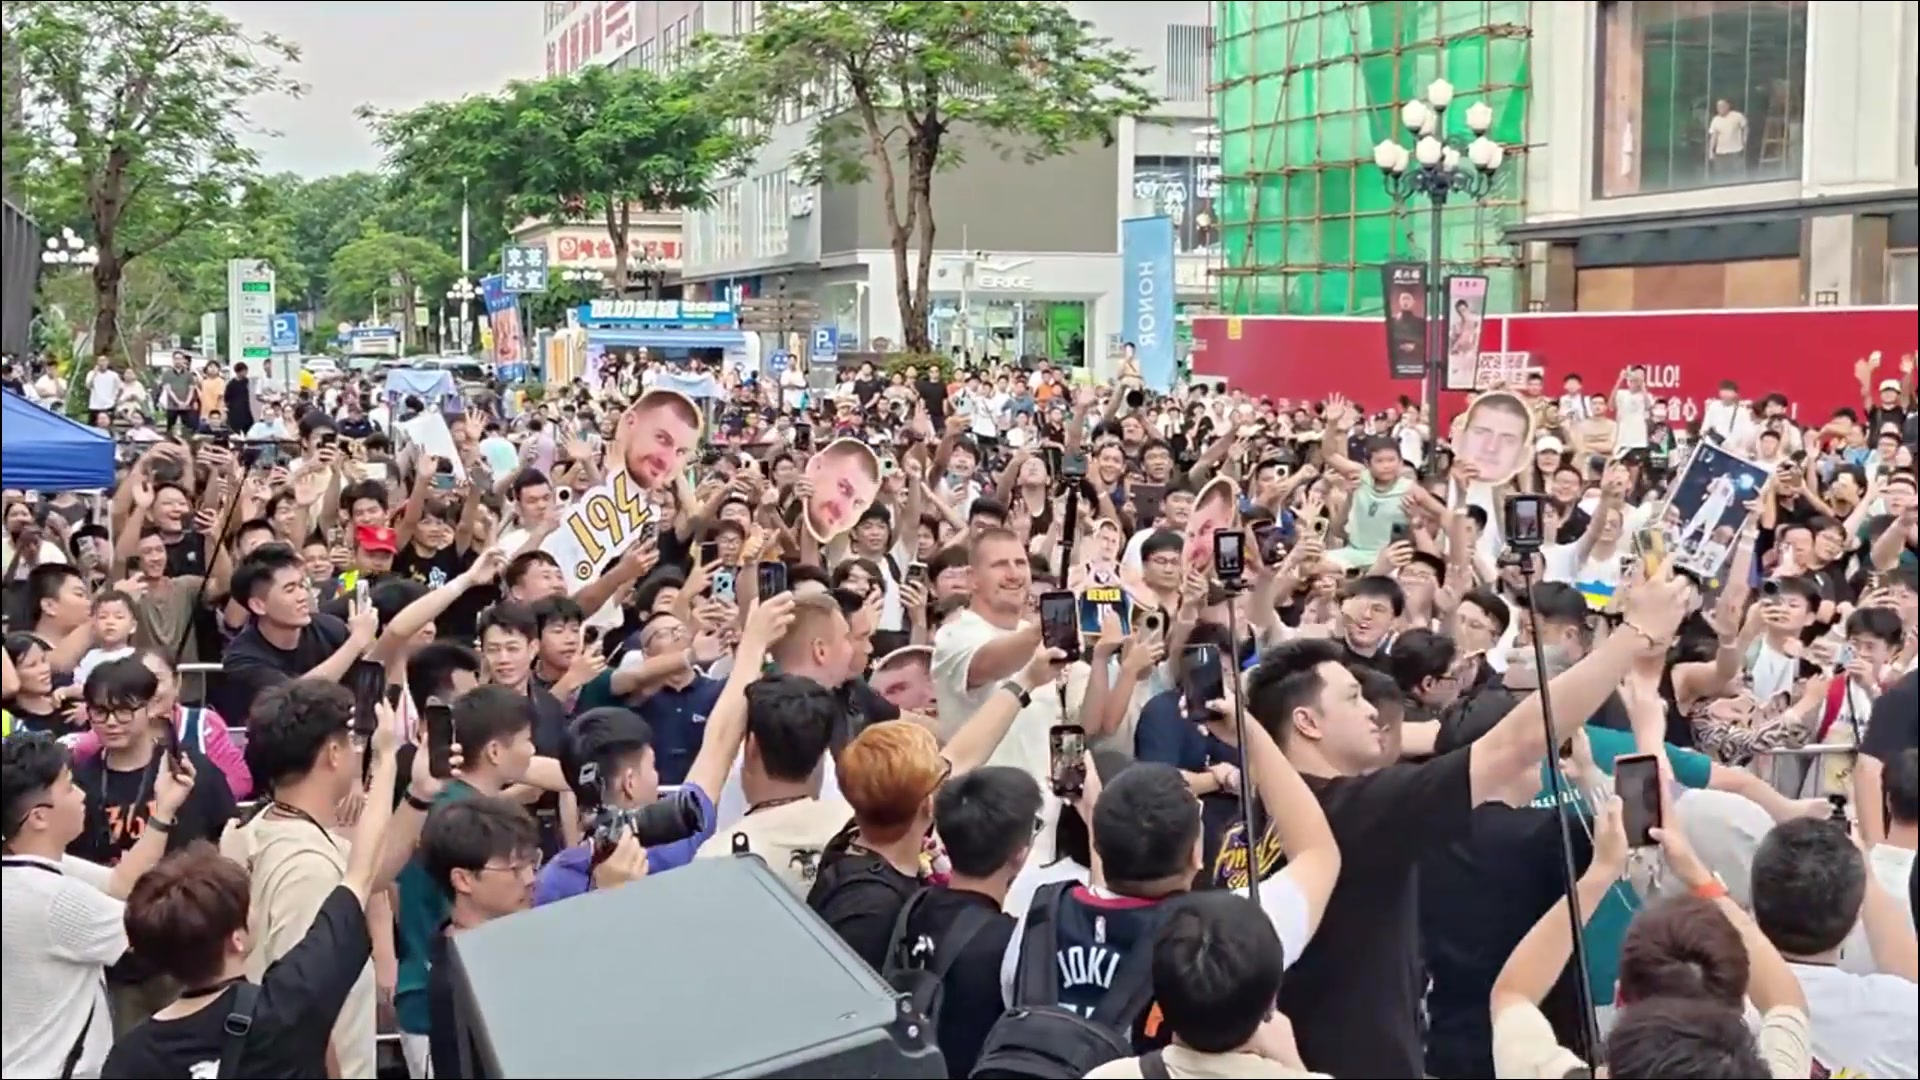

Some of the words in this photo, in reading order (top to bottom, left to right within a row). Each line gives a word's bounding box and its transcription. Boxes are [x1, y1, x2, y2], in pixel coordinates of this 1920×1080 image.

[505, 270, 543, 289] 冰室
[980, 276, 1034, 289] ERKE
[274, 319, 288, 338] P
[816, 331, 829, 348] P
[1626, 364, 1681, 388] LLO!
